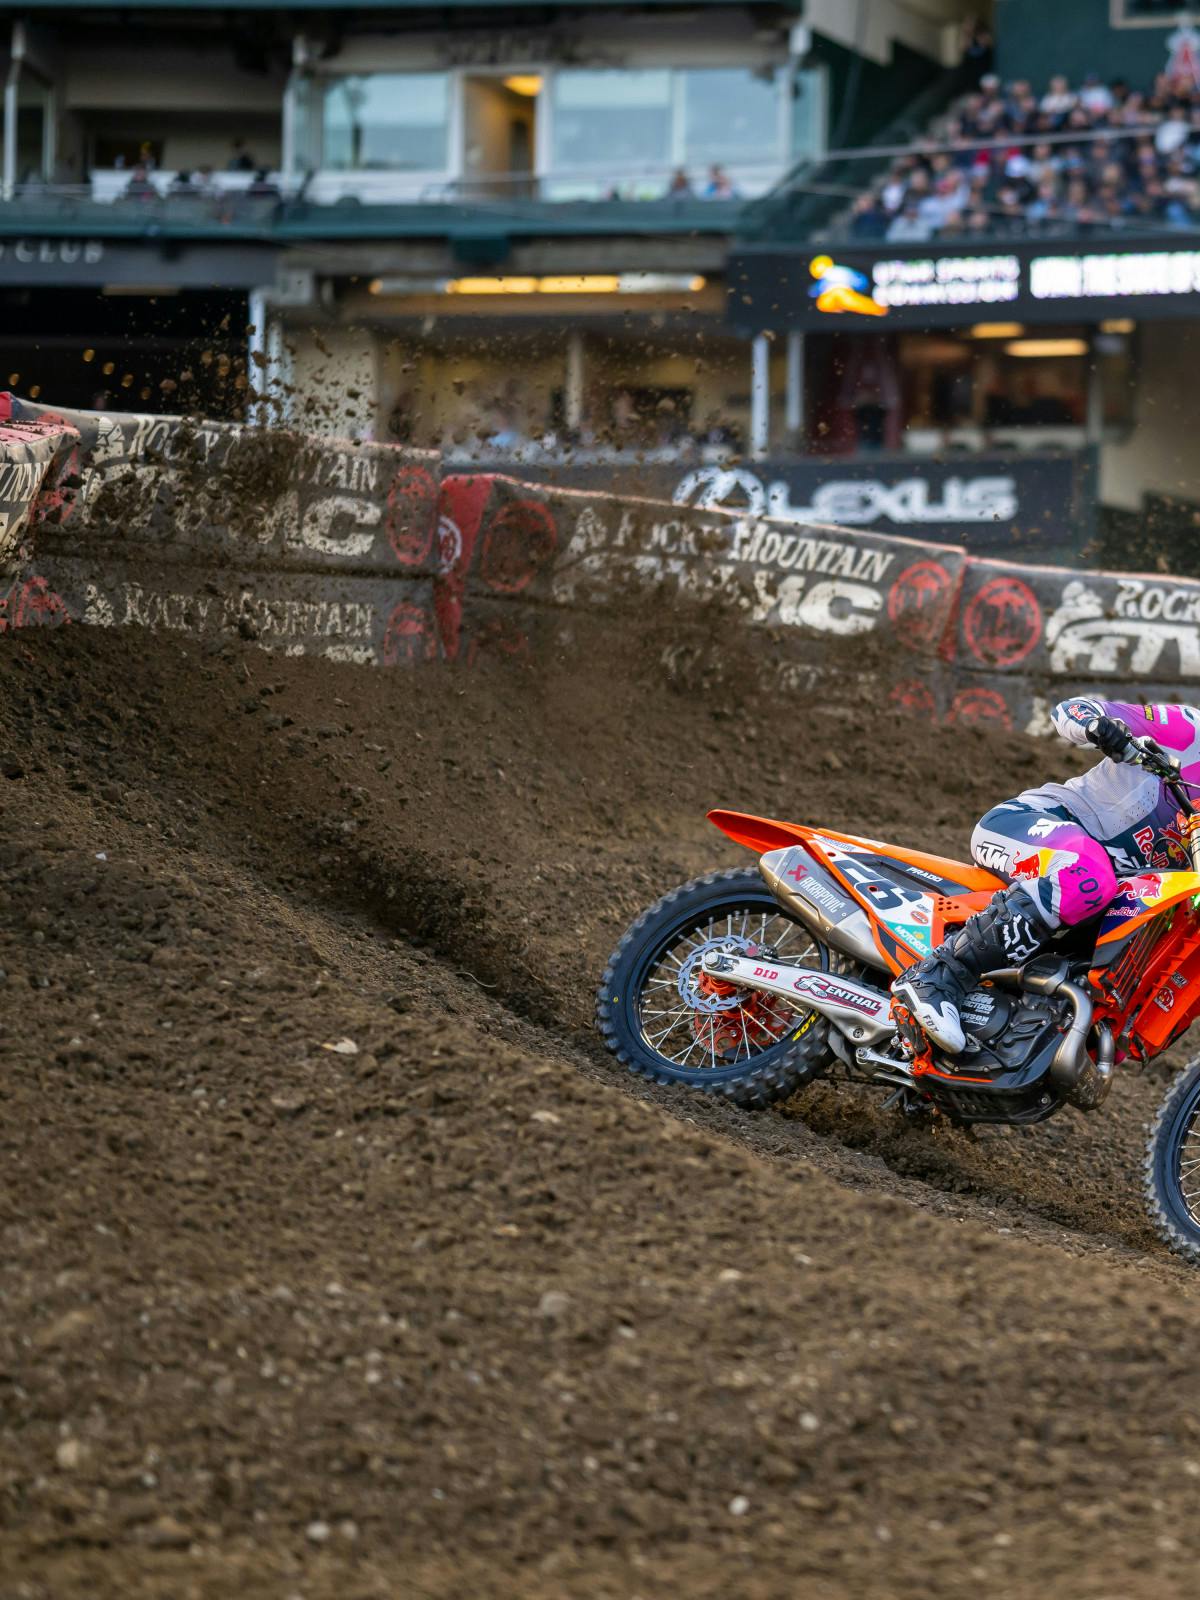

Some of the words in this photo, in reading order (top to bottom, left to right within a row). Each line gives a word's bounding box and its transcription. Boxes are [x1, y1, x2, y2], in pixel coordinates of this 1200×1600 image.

[15, 240, 103, 263] CLUB
[768, 477, 1019, 524] LEXUS
[731, 519, 895, 583] MOUNTAIN
[976, 841, 1010, 873] KTM
[906, 866, 944, 883] PRADO
[893, 925, 932, 955] MOTOREX
